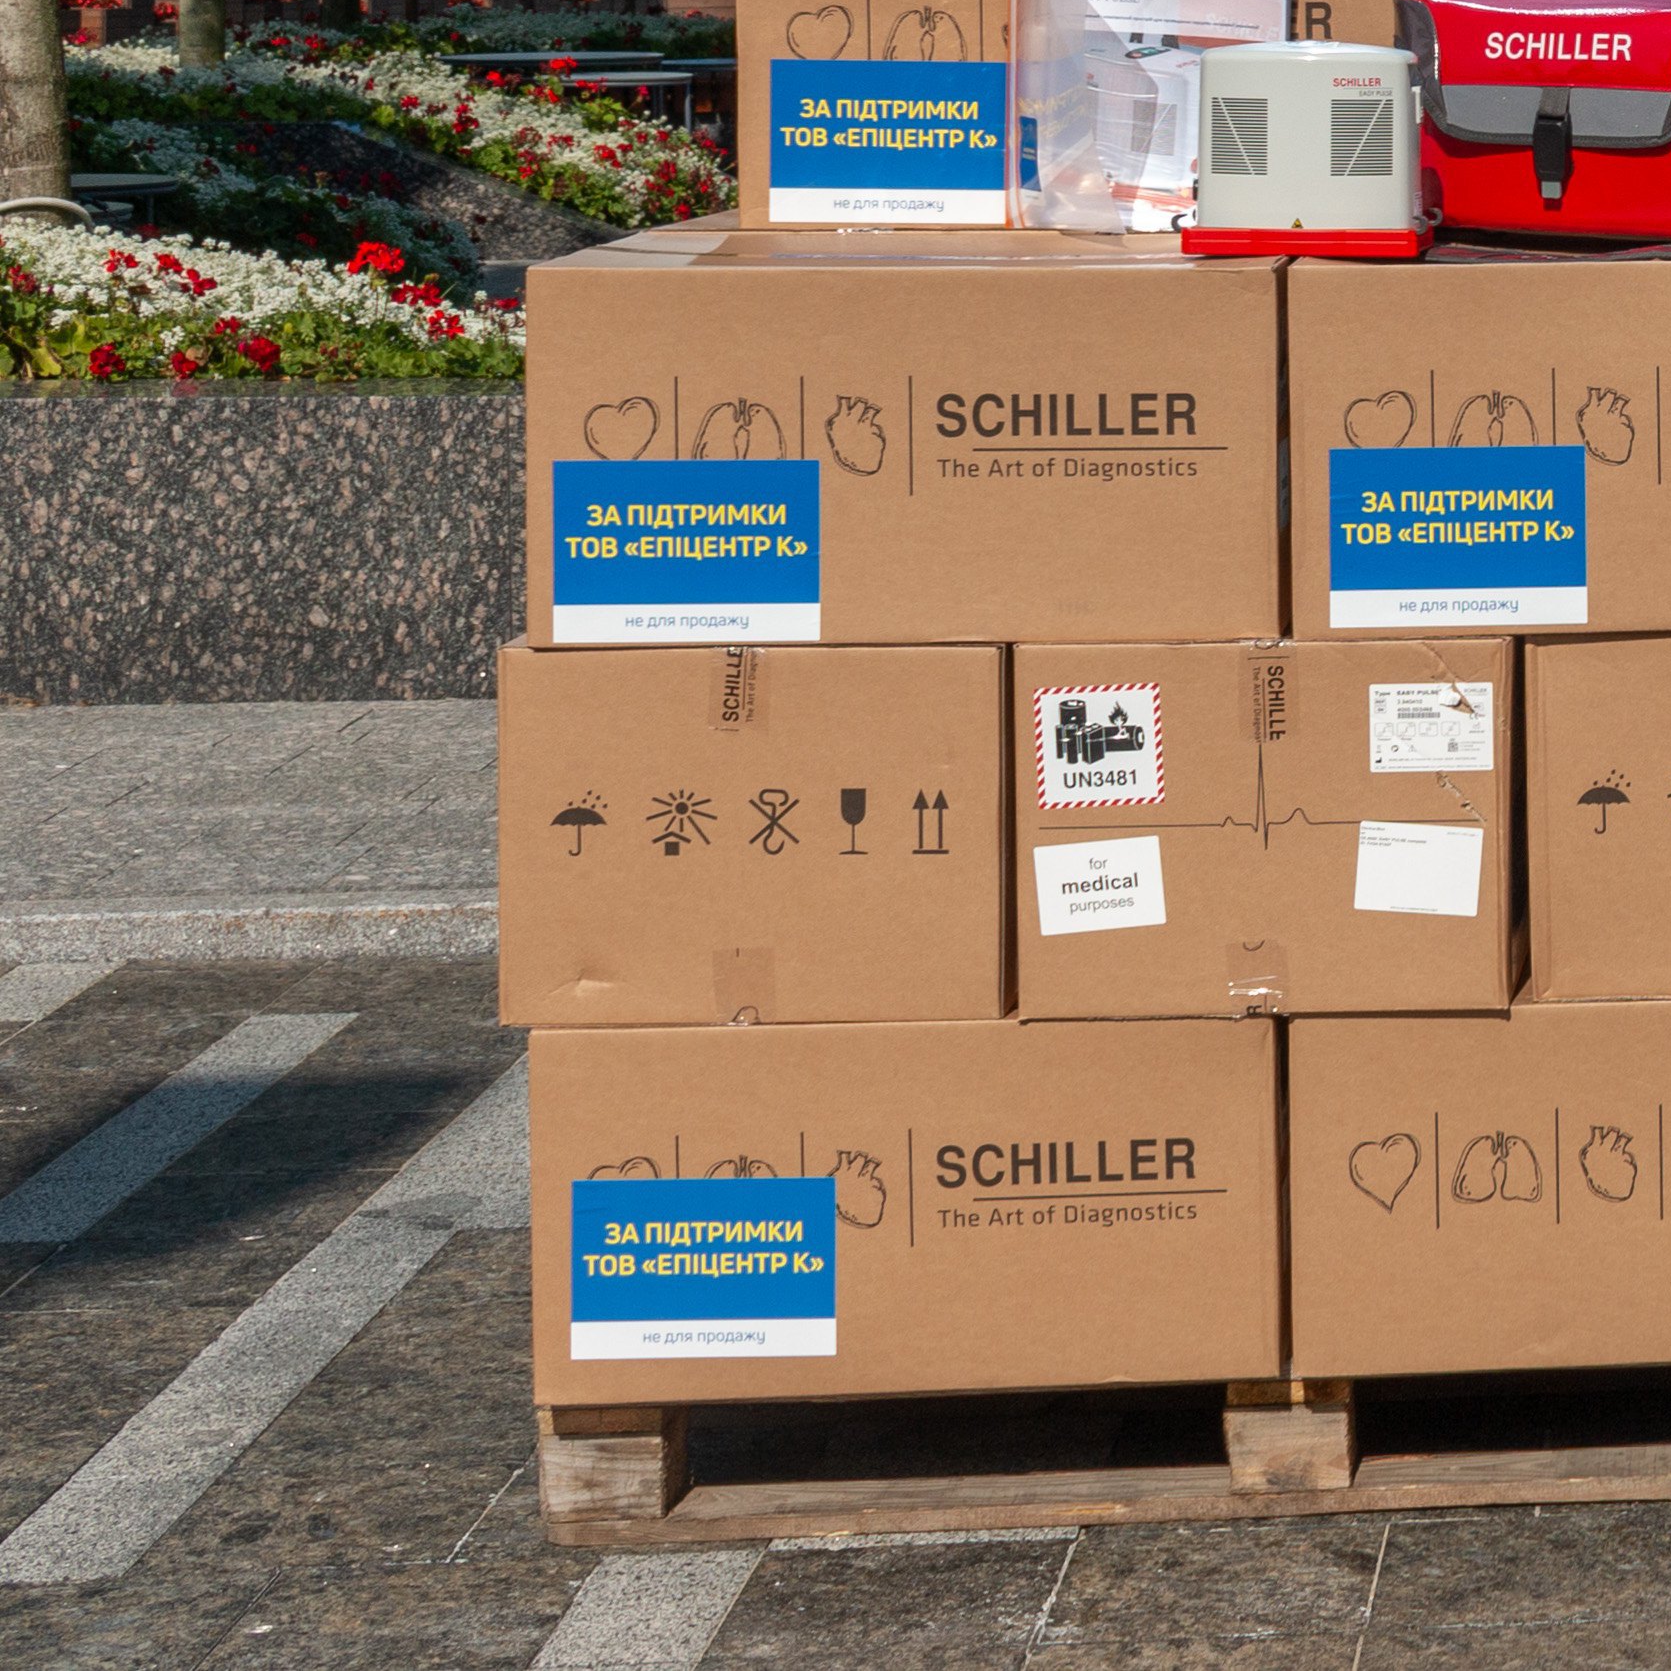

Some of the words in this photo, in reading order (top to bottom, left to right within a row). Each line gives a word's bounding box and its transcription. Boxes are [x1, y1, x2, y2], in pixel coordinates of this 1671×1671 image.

[1484, 31, 1632, 62] SCHILLER
[1332, 77, 1382, 88] SCHILLER
[799, 98, 832, 119] ЗА
[836, 98, 979, 123] ПІДТРИМКИ
[779, 126, 829, 147] ТОВ
[833, 127, 966, 151] «ЕПІЦЕНТР
[969, 129, 998, 149] К»
[833, 199, 851, 209] не
[852, 199, 879, 211] для
[882, 199, 945, 213] продажу
[936, 393, 1196, 437] SCHILLER
[936, 457, 980, 480] The
[987, 457, 1025, 479] Art
[1030, 456, 1055, 478] of
[1064, 456, 1198, 482] Diagnostics
[1361, 490, 1396, 513] ЗА
[1400, 488, 1554, 516] ПІДТРИМКИ
[586, 504, 623, 527] ЗА
[627, 503, 787, 530] ПІДТРИМКИ
[1340, 522, 1393, 545] ТОВ
[1397, 520, 1540, 547] «ЕПІЦЕНТР
[1544, 520, 1575, 542] К»
[564, 536, 619, 559] ТОВ
[623, 535, 772, 561] «ЕПІЦЕНТР
[776, 535, 809, 557] К»
[1399, 601, 1417, 612] не
[1419, 600, 1448, 614] для
[1452, 599, 1519, 614] продажу
[625, 616, 644, 628] не
[646, 616, 676, 629] для
[679, 615, 750, 630] продажу
[722, 647, 743, 722] SCHILLE
[1268, 666, 1286, 741] SCHILLE
[1063, 769, 1137, 789] UN3481
[1088, 857, 1108, 870] for
[1061, 872, 1139, 895] medical
[1069, 896, 1135, 916] purposes
[937, 1138, 1197, 1188] SCHILLER
[936, 1208, 980, 1229] The
[988, 1207, 1024, 1227] Art
[1032, 1204, 1056, 1225] of
[1064, 1202, 1198, 1228] Diagnostics
[604, 1222, 640, 1245] ЗА
[644, 1220, 804, 1247] ПІДТРИМКИ
[582, 1253, 637, 1277] ТОВ
[641, 1251, 788, 1279] «ЕПІЦЕНТР
[792, 1251, 825, 1274] К»
[642, 1332, 662, 1344] не
[665, 1332, 693, 1345] для
[697, 1331, 766, 1345] продажу
